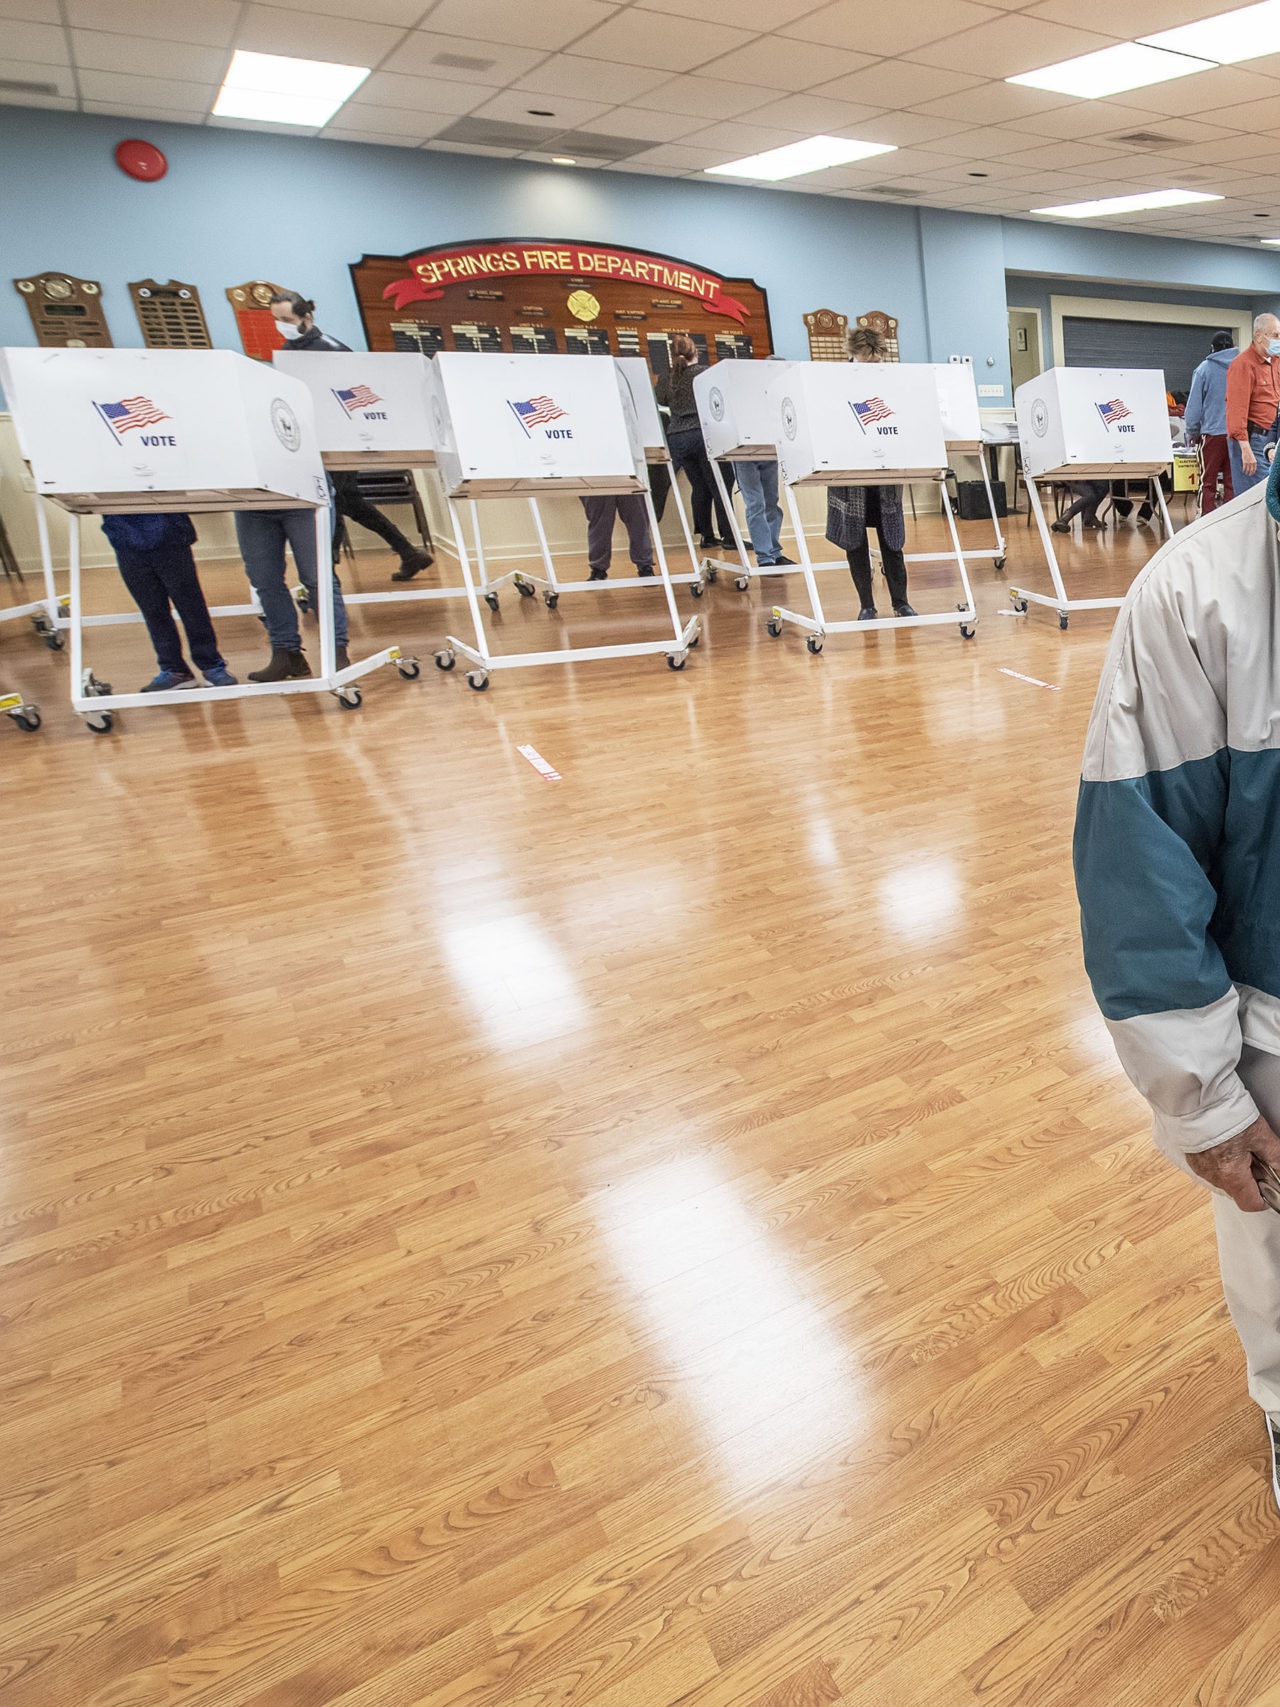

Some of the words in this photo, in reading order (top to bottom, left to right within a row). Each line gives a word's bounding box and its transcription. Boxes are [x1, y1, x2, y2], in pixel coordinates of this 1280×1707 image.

[416, 251, 521, 284] SPRINGS
[523, 250, 574, 270] FIRE
[578, 252, 720, 299] DEPARTMENT
[363, 411, 389, 421] VOTE
[876, 426, 899, 436] VOTE
[1117, 425, 1136, 433] VOTE
[545, 429, 574, 440] VOTE
[140, 435, 177, 447] VOTE
